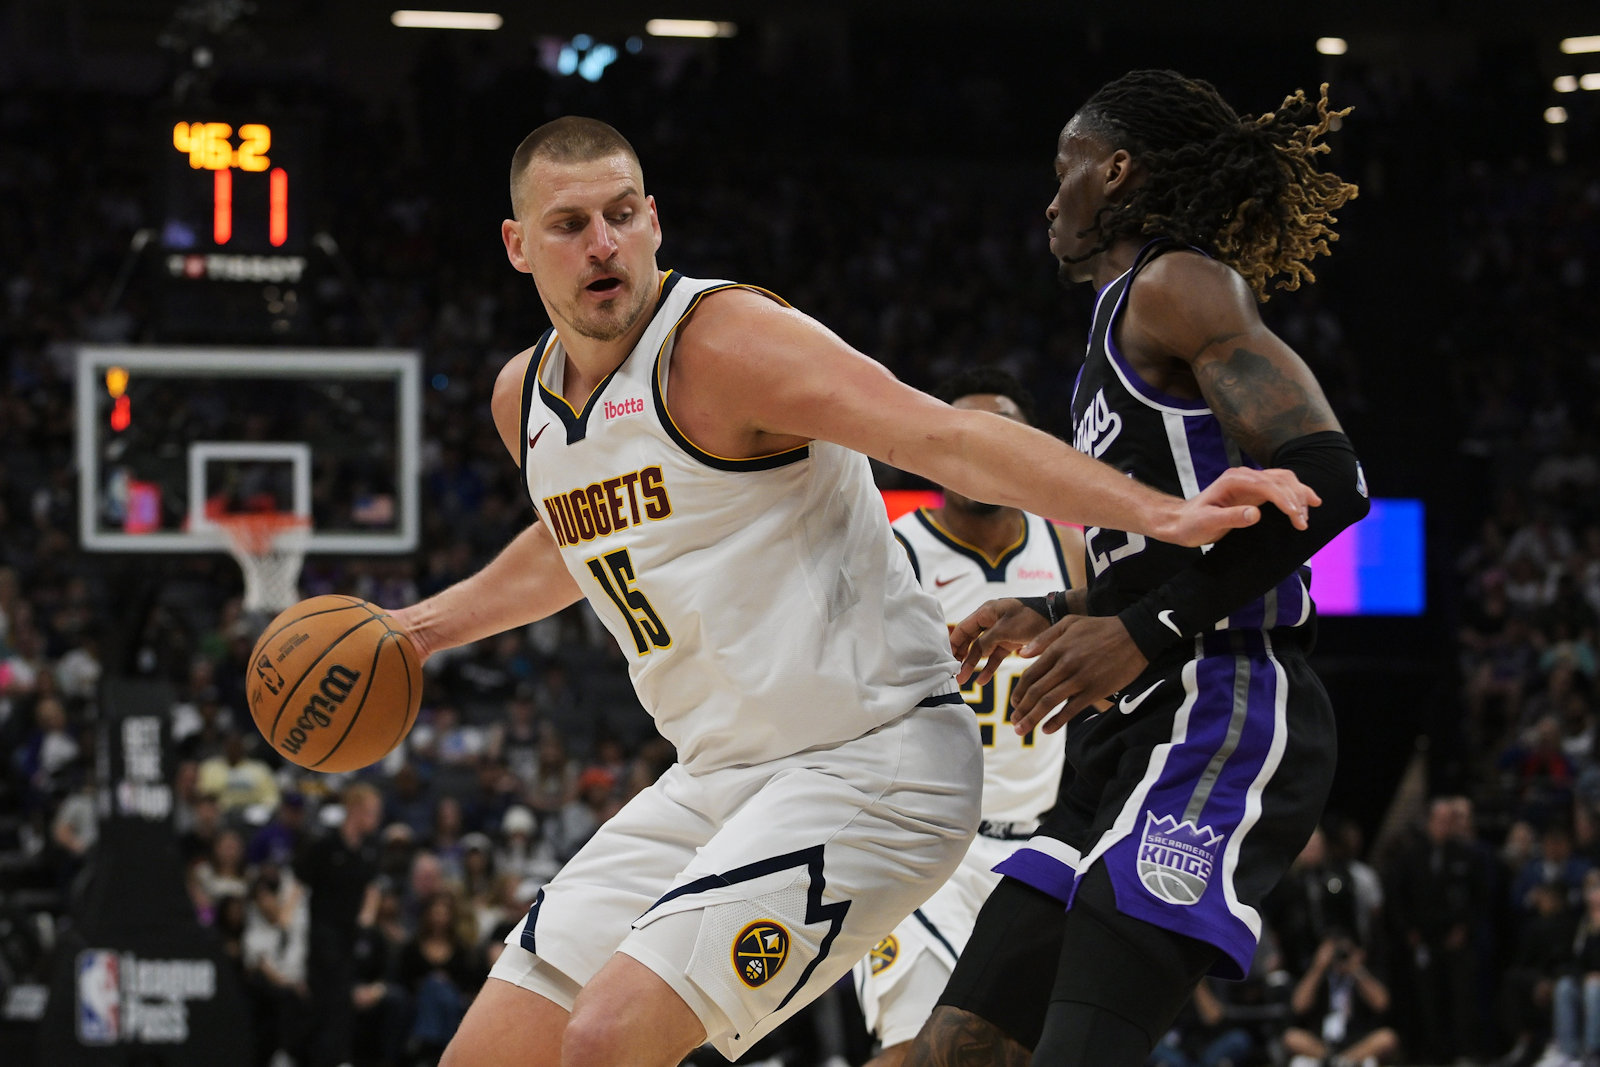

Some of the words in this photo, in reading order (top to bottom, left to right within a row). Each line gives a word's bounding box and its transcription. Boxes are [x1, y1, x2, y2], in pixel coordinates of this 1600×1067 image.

[603, 397, 644, 420] ibotta
[543, 464, 673, 548] NUGGETS
[585, 546, 673, 657] 15
[281, 663, 362, 755] Wilson
[1141, 845, 1213, 882] KINGS
